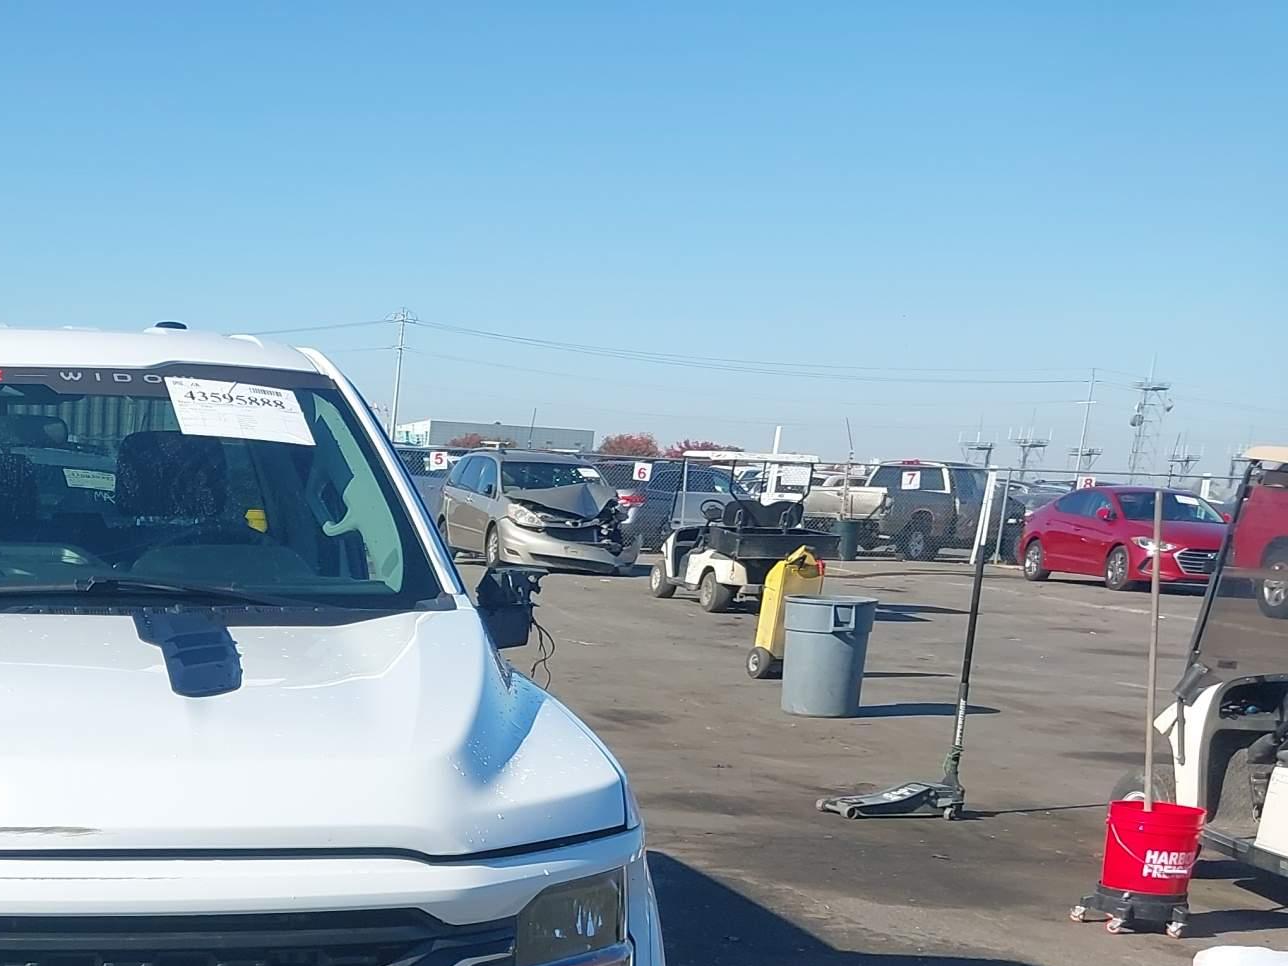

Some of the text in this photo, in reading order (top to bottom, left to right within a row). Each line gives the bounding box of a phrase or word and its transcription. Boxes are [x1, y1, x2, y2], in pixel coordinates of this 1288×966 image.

[59, 371, 194, 384] WIDO
[184, 390, 286, 410] 43595888
[434, 452, 444, 465] 5
[637, 467, 647, 480] 6
[906, 472, 917, 485] 7
[1083, 478, 1093, 489] 8
[1145, 849, 1196, 865] HARBO
